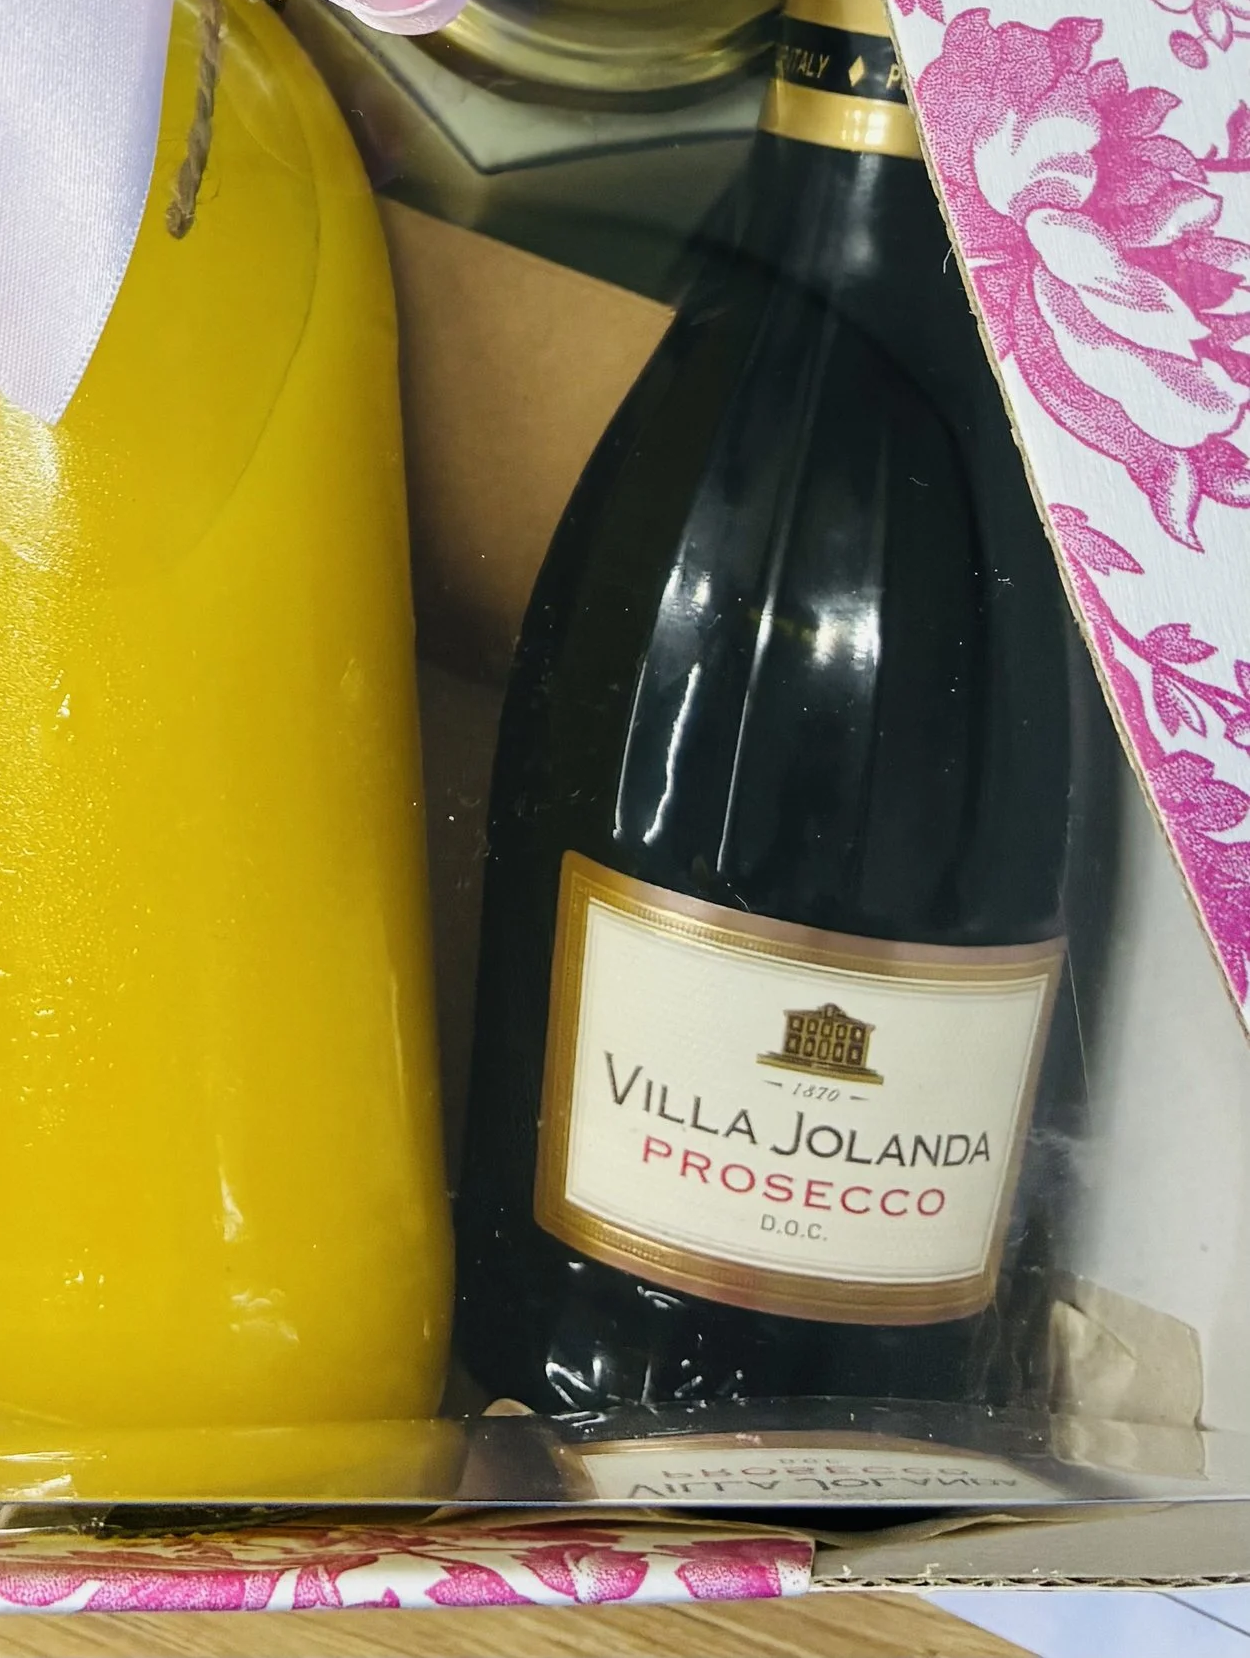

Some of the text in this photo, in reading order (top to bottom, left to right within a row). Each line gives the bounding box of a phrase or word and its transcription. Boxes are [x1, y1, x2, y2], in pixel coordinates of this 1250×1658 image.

[604, 1051, 992, 1168] VILLA JOLANDA
[790, 1081, 842, 1104] 1870
[642, 1135, 946, 1218] PROSECCO
[759, 1213, 829, 1242] D.O.C.
